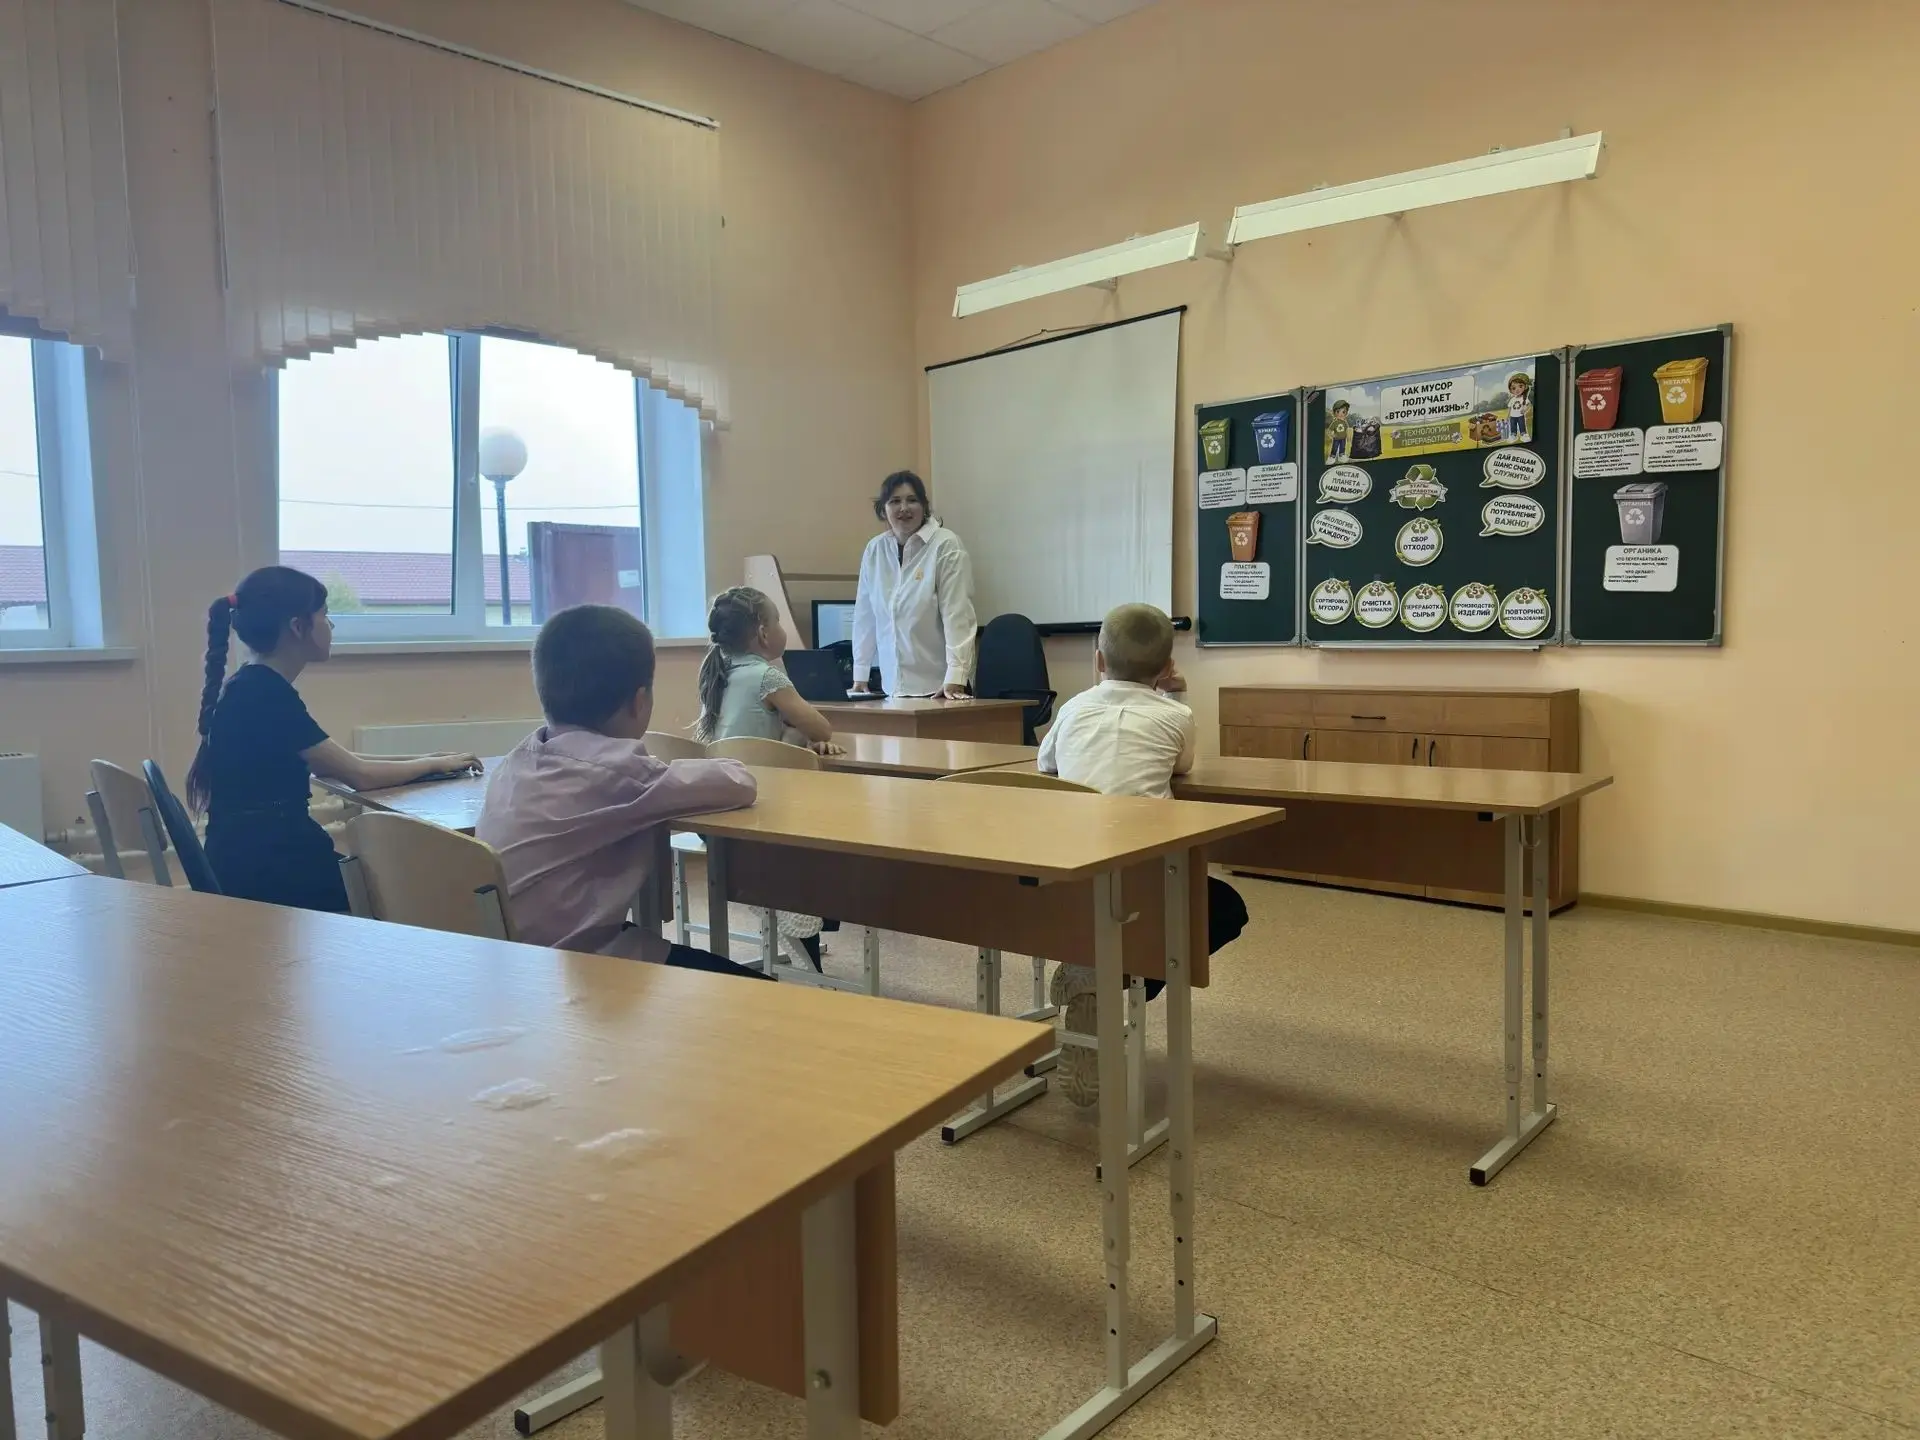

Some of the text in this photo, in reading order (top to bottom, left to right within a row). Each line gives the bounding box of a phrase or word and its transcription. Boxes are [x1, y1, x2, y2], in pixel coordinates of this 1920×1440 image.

[1401, 381, 1453, 396] КАК МУСОР
[1402, 392, 1452, 407] ПОЛУЧАЕТ
[1385, 402, 1470, 420] «ВТОРУЮ ЖИЗНЬ»?
[1403, 426, 1450, 437] ТЕХНОЛОГИИ
[1584, 430, 1635, 441] ЭЛЕКТРОНИКА
[1668, 426, 1702, 434] МЕТАЛЛ
[1402, 435, 1450, 447] ПЕРЕРАБОТКИ
[1512, 455, 1537, 466] ВЕЩАМ
[1493, 460, 1534, 474] ШАНС СНОВА
[1336, 470, 1360, 478] ЧИСТАЯ
[1494, 468, 1530, 480] СЛУЖИТЬ!
[1332, 478, 1360, 486] ПЛАНЕТА
[1340, 487, 1362, 495] ВЫБОР!
[1494, 501, 1536, 511] ОСОЗНАННОЕ
[1490, 508, 1537, 519] ПОТРЕБЛЕНИЕ
[1324, 514, 1354, 530] ЭКОЛОГИЯ
[1494, 518, 1530, 528] ВАЖНО!
[1318, 526, 1350, 542] КАЖДОГО!
